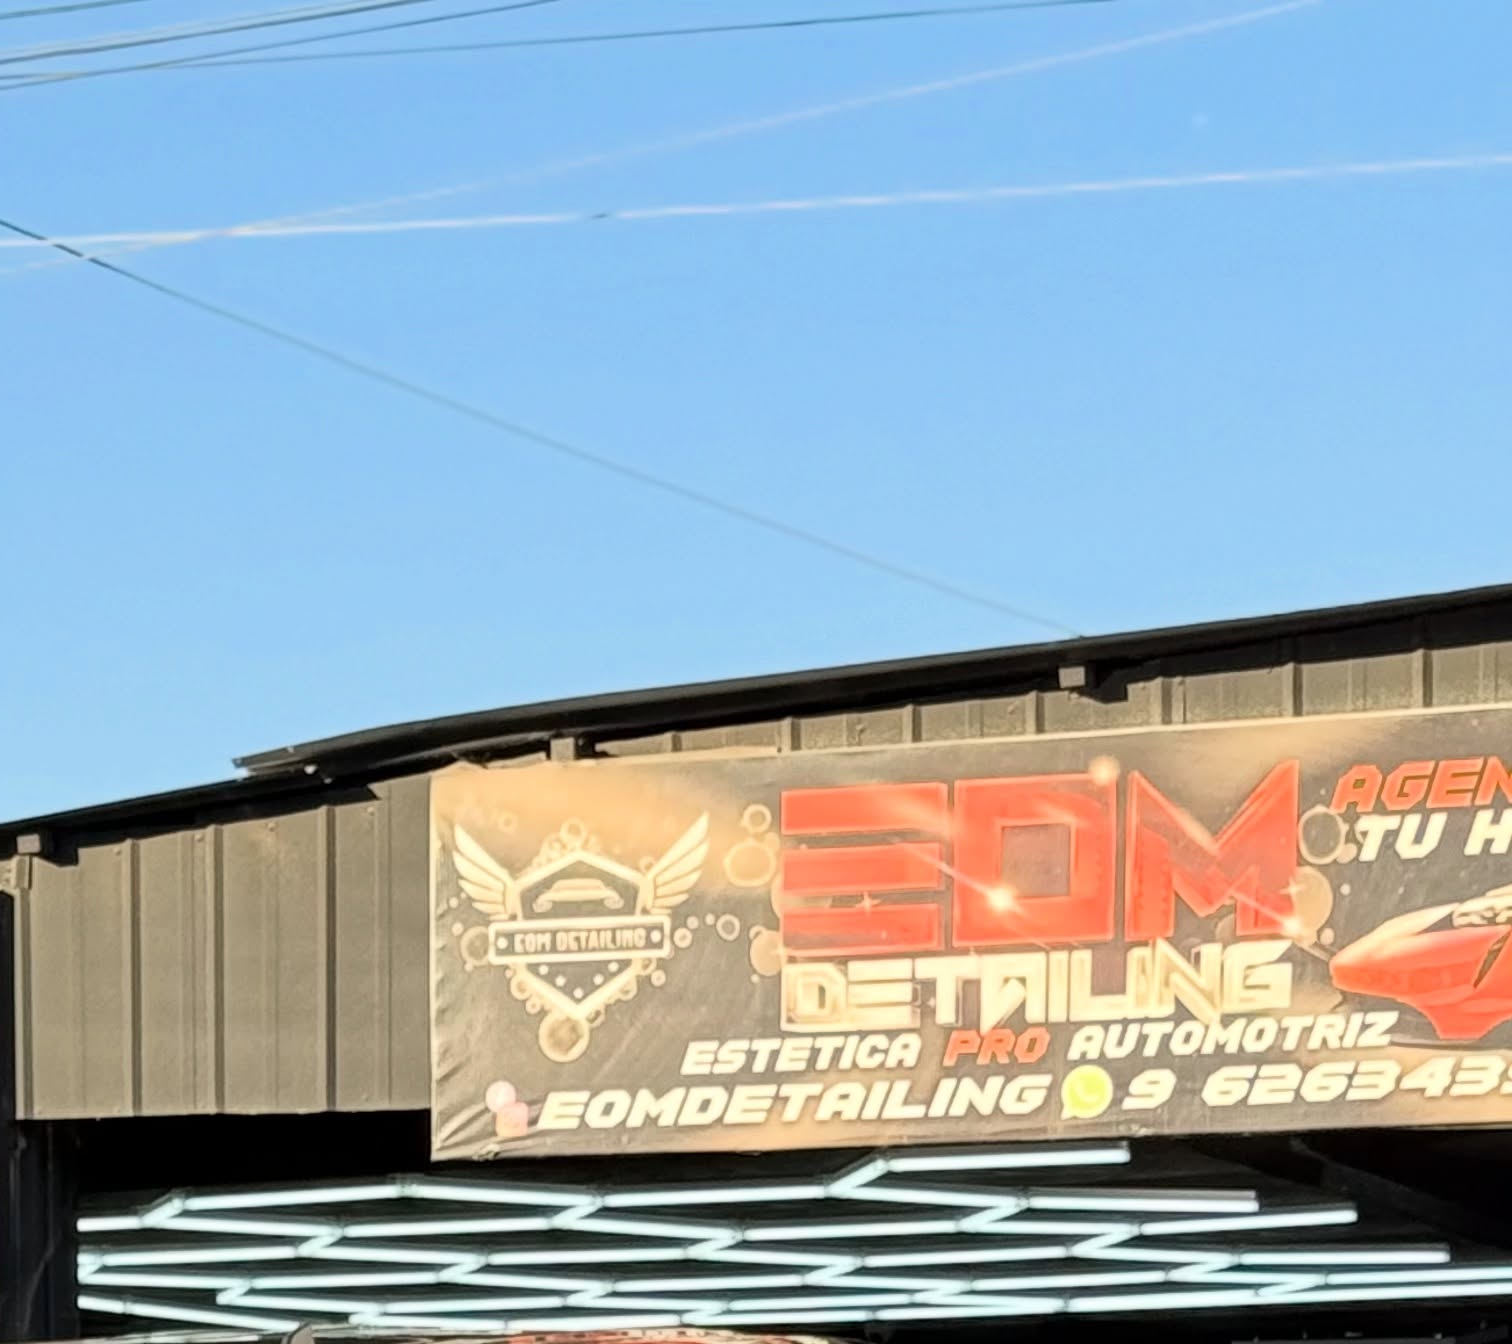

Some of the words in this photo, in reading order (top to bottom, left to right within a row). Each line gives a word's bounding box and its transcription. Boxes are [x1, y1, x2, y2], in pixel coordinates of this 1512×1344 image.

[1358, 812, 1448, 862] TU
[514, 932, 552, 954] EOM
[555, 927, 647, 952] DETAILING
[780, 938, 1294, 1033] DETAILING
[679, 1032, 923, 1076] ESTETICA
[941, 1027, 1051, 1068] PRO
[1066, 1010, 1400, 1062] AUTOMOTRIZ
[535, 1073, 1054, 1130] EOMDETAILING
[1121, 1068, 1178, 1110] 9
[1200, 1054, 1512, 1108] 626343
